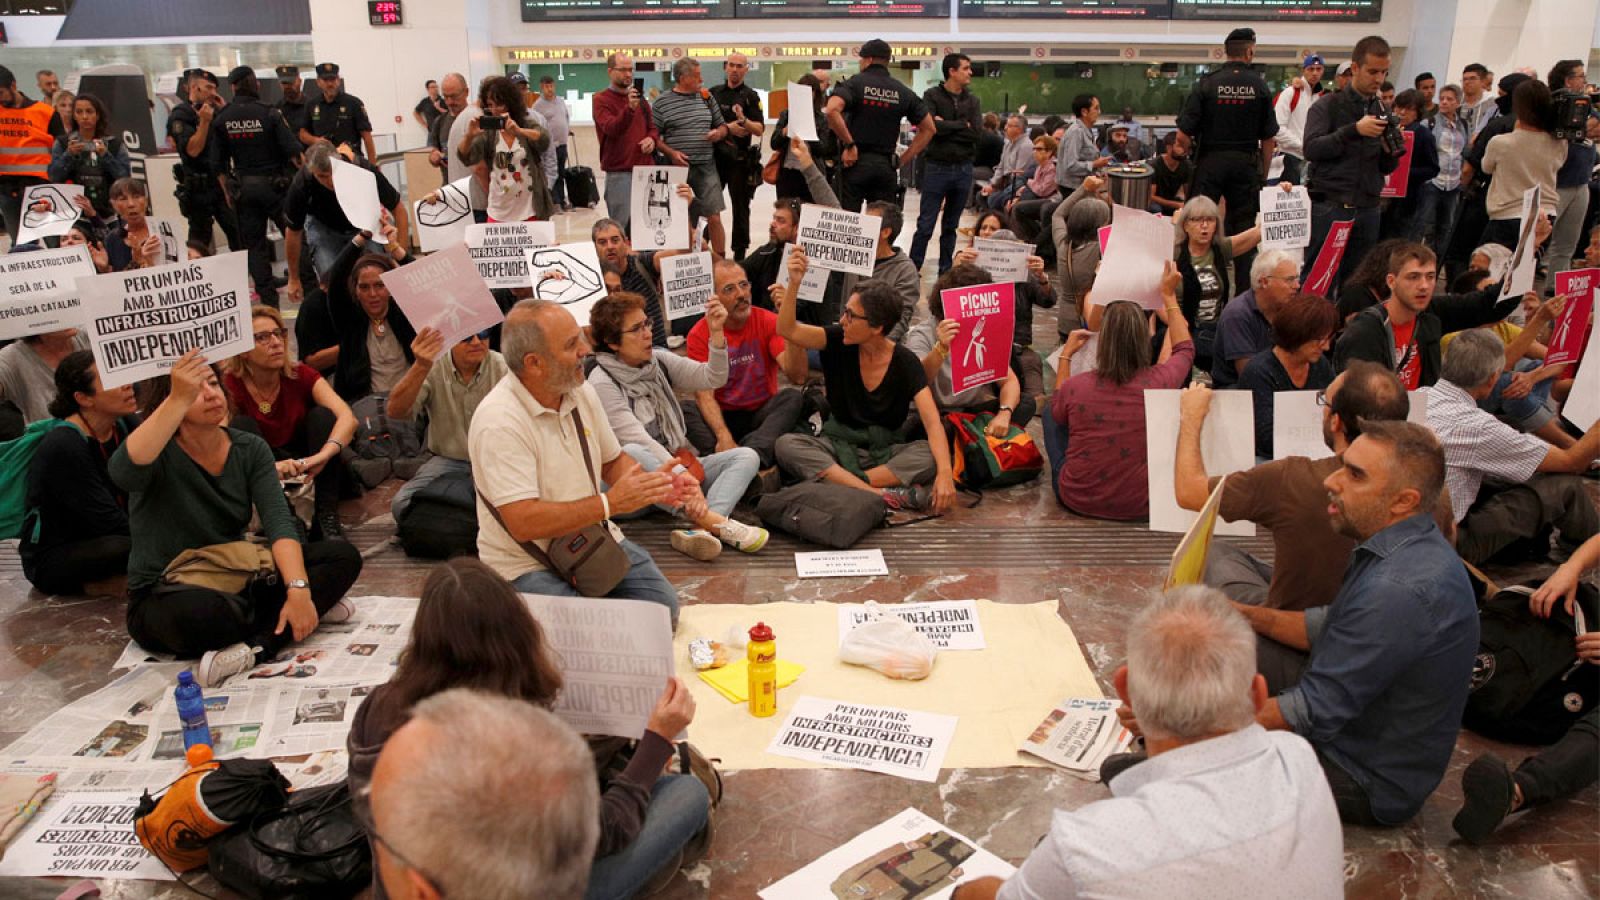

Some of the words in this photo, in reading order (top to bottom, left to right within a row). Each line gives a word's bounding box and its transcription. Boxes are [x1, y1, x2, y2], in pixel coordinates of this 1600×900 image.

[515, 50, 544, 59] TRAIN
[549, 49, 573, 58] INFO
[638, 48, 663, 57] INFO
[782, 48, 812, 56] TRAIN
[817, 48, 842, 56] INFO
[908, 48, 932, 56] INFO
[864, 86, 899, 99] POLICIA
[1218, 86, 1256, 95] POLICIA
[225, 119, 262, 129] POLICIA
[485, 227, 499, 236] PER
[500, 226, 510, 235] UN
[483, 237, 500, 246] AMB
[501, 235, 533, 245] MILLORS
[8, 254, 82, 273] INFRAESTRUCTURA
[124, 275, 150, 293] PER
[152, 271, 172, 288] UN
[174, 264, 204, 285] PAÍS
[9, 282, 32, 295] SERÀ
[33, 282, 44, 291] DE
[45, 280, 57, 289] LA
[123, 294, 155, 312] AMB
[158, 283, 214, 307] MILLORS
[959, 291, 1000, 311] PÍCNIC
[0, 305, 39, 319] EPÚBLICA
[96, 292, 236, 335] INFRAESTRUCTURES
[104, 316, 239, 369] INDEPENDÈNCIA
[835, 704, 860, 716] PER
[860, 707, 880, 717] UN
[879, 709, 909, 722] PAÍS
[824, 712, 852, 723] AMB
[856, 717, 912, 733] MILLORS
[792, 716, 933, 748] INFRAESTRUCTURES
[782, 730, 924, 768] INDEPENDÈNCIA
[36, 829, 140, 846] STRUCTURES
[53, 844, 121, 857] MILLORS
[48, 858, 86, 872] PAÍS
[85, 859, 110, 872] UN
[110, 860, 140, 872] PER
